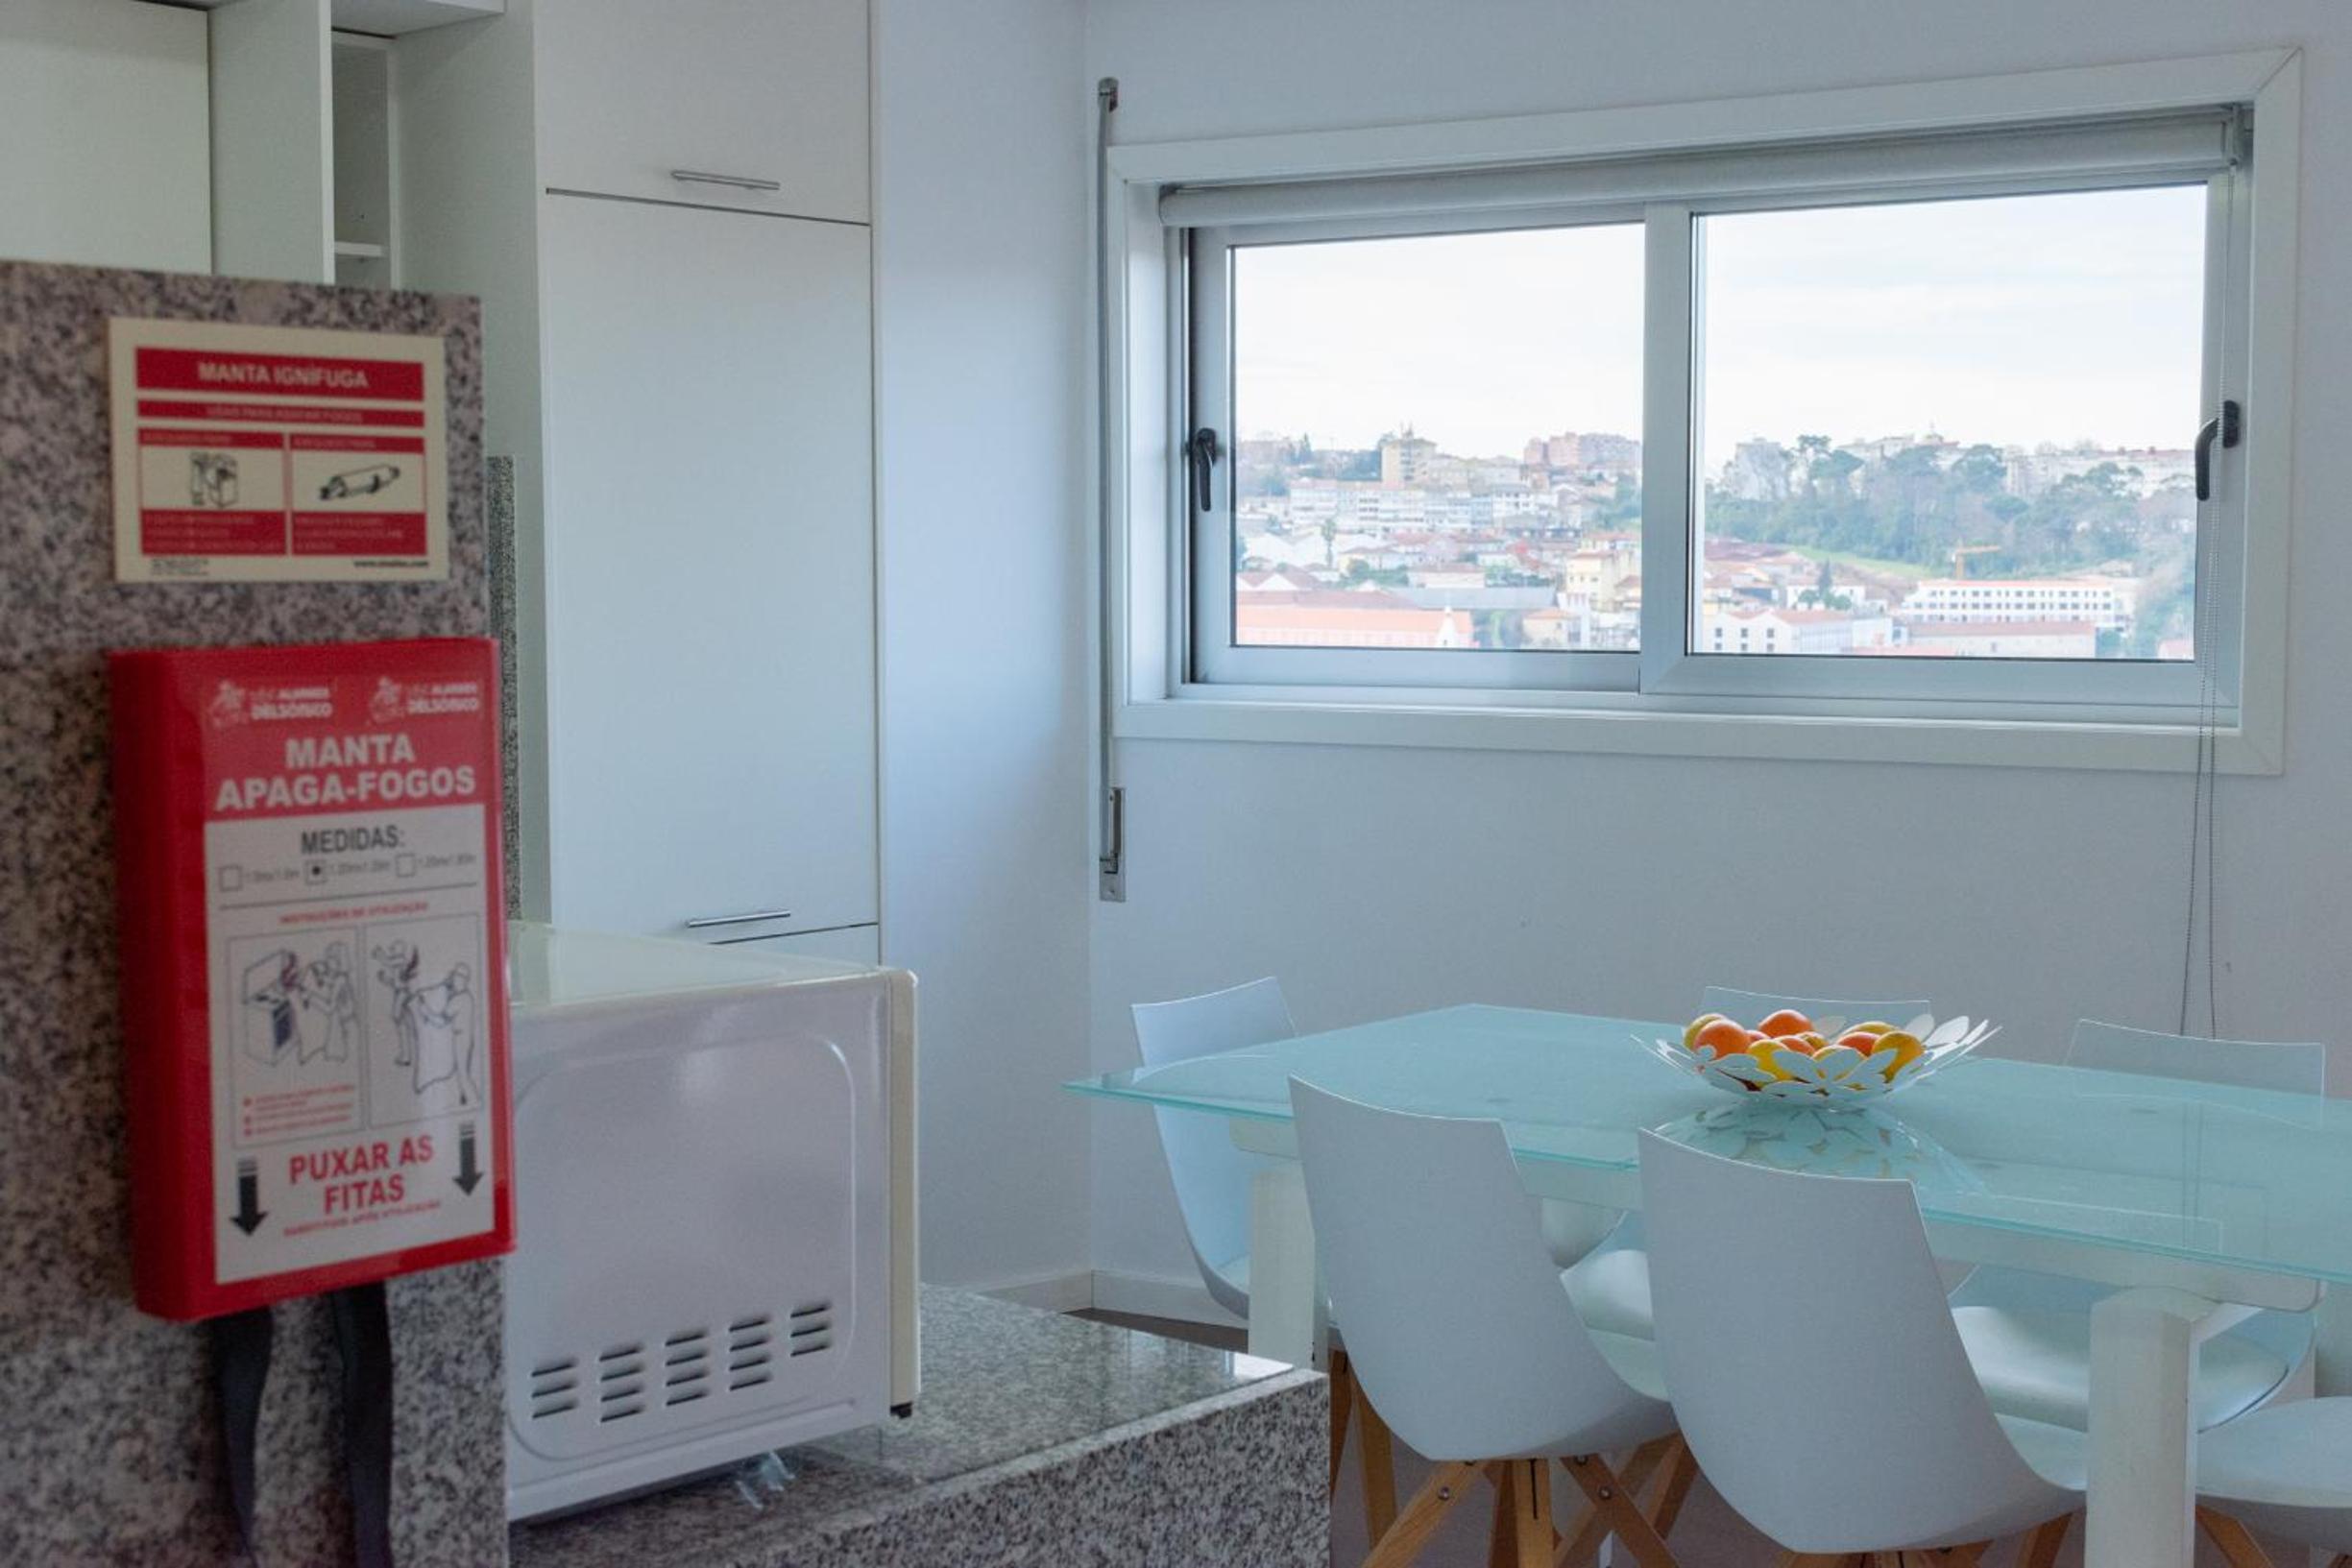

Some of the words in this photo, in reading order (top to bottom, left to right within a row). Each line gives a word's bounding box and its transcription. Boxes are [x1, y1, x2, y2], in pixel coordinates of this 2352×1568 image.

[199, 361, 270, 383] MANTA
[285, 733, 416, 769] MANTA
[215, 765, 476, 811] APAGA-FOGOS
[301, 825, 404, 856] MEDIDAS:
[290, 1141, 391, 1185] PUXAR
[399, 1134, 434, 1164] AS
[324, 1173, 405, 1215] FITAS
